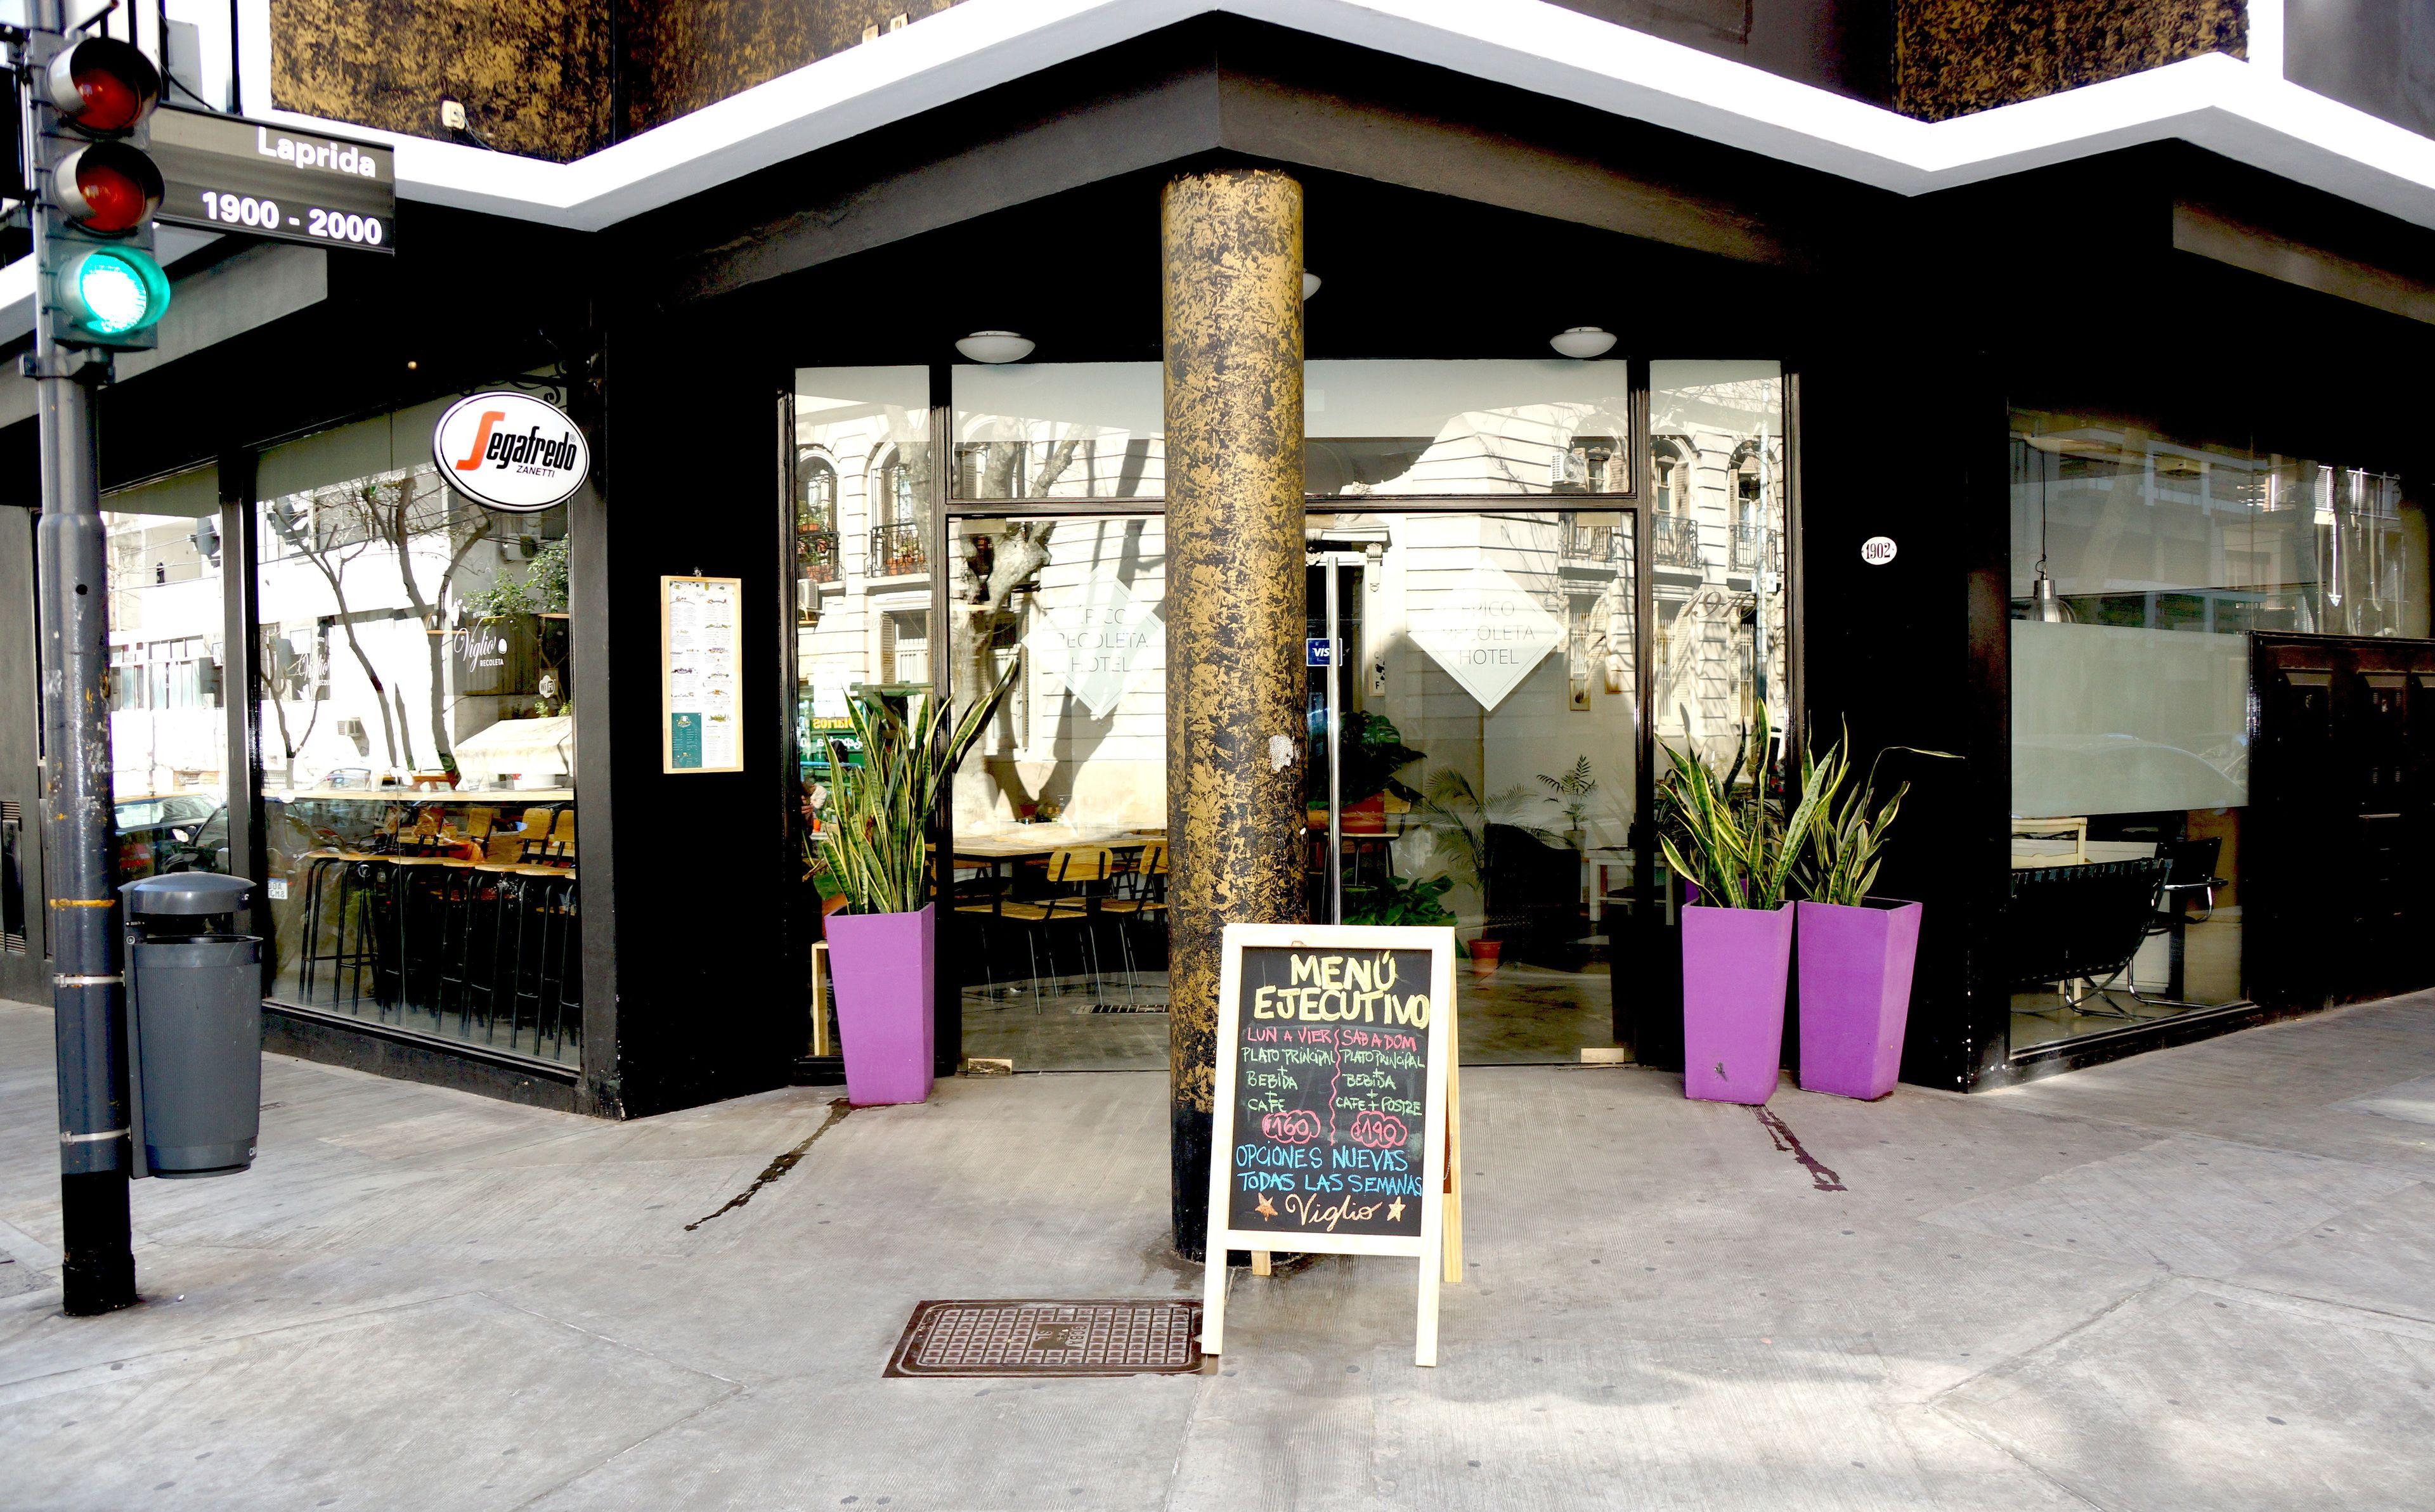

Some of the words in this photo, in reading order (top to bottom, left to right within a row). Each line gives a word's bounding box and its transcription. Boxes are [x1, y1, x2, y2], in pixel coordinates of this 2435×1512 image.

[258, 126, 376, 178] Laprida
[202, 191, 280, 229] 1900
[309, 208, 382, 245] 2000
[455, 410, 578, 472] Segafredo
[516, 465, 555, 479] ZANETTI
[1866, 542, 1891, 560] 1902
[453, 617, 497, 673] Viglio
[1312, 647, 1330, 657] VIS
[480, 659, 504, 667] RECOLETA
[1460, 649, 1519, 665] HOTEL
[1290, 950, 1396, 992] MENÚ
[1254, 985, 1430, 1030] EJECUTIVO
[1247, 1026, 1277, 1044] LUN
[1283, 1030, 1293, 1042] A
[1297, 1026, 1332, 1045] VIER
[1341, 1029, 1368, 1047] SAB
[1371, 1033, 1383, 1048] A
[1383, 1033, 1417, 1052] DOM
[1241, 1047, 1280, 1064] PLATO
[1339, 1049, 1375, 1064] PLATO
[1245, 1070, 1298, 1090] BEBIDA
[1342, 1073, 1397, 1090] BEBIDA
[1247, 1098, 1287, 1113] CAFE
[1335, 1095, 1367, 1111] CAFE
[1381, 1096, 1423, 1116] POSTRE
[1236, 1140, 1323, 1169] OPCIONES
[1332, 1145, 1409, 1172] NUEVAS
[1237, 1171, 1296, 1192] TODAS
[1304, 1173, 1344, 1193] LAS
[1347, 1173, 1423, 1197] SEMANAS
[1285, 1192, 1383, 1232] Viglio
